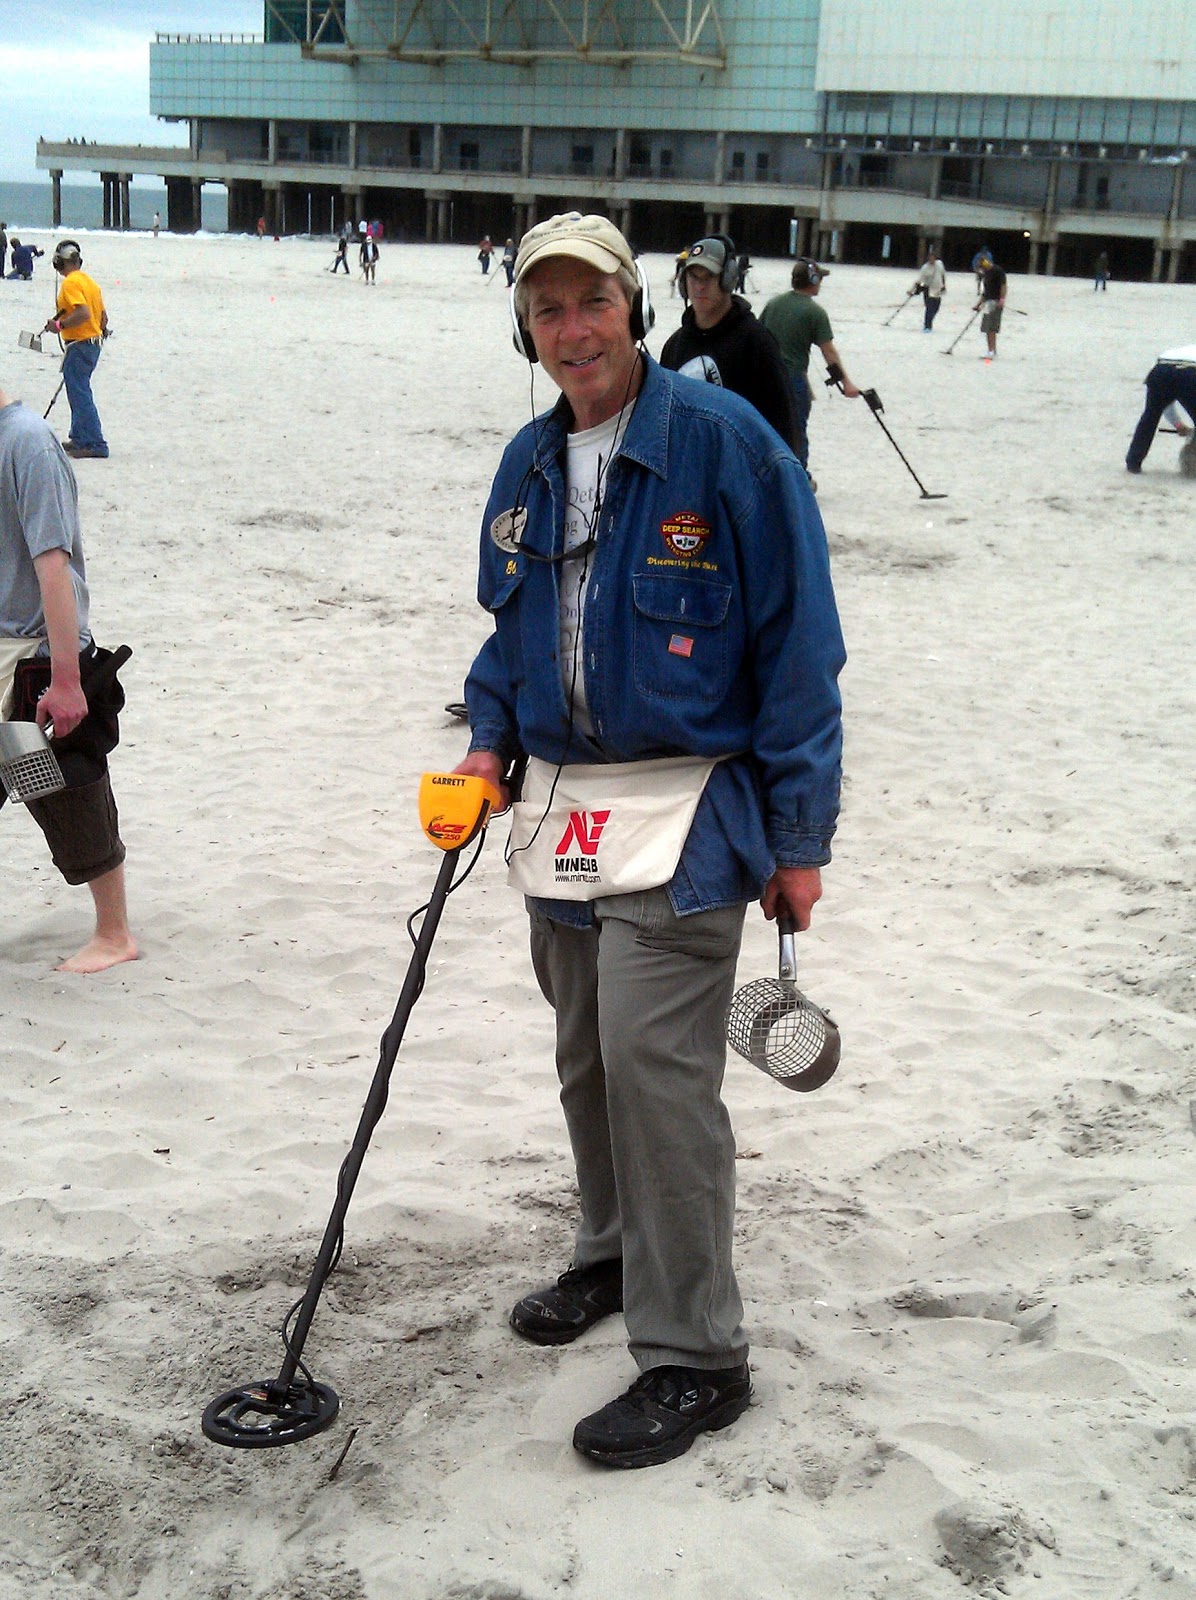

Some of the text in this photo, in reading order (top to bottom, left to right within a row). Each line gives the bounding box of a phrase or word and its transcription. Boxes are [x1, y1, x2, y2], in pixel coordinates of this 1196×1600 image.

[662, 524, 710, 535] DEEP SEARCH
[432, 777, 466, 787] GARRETT
